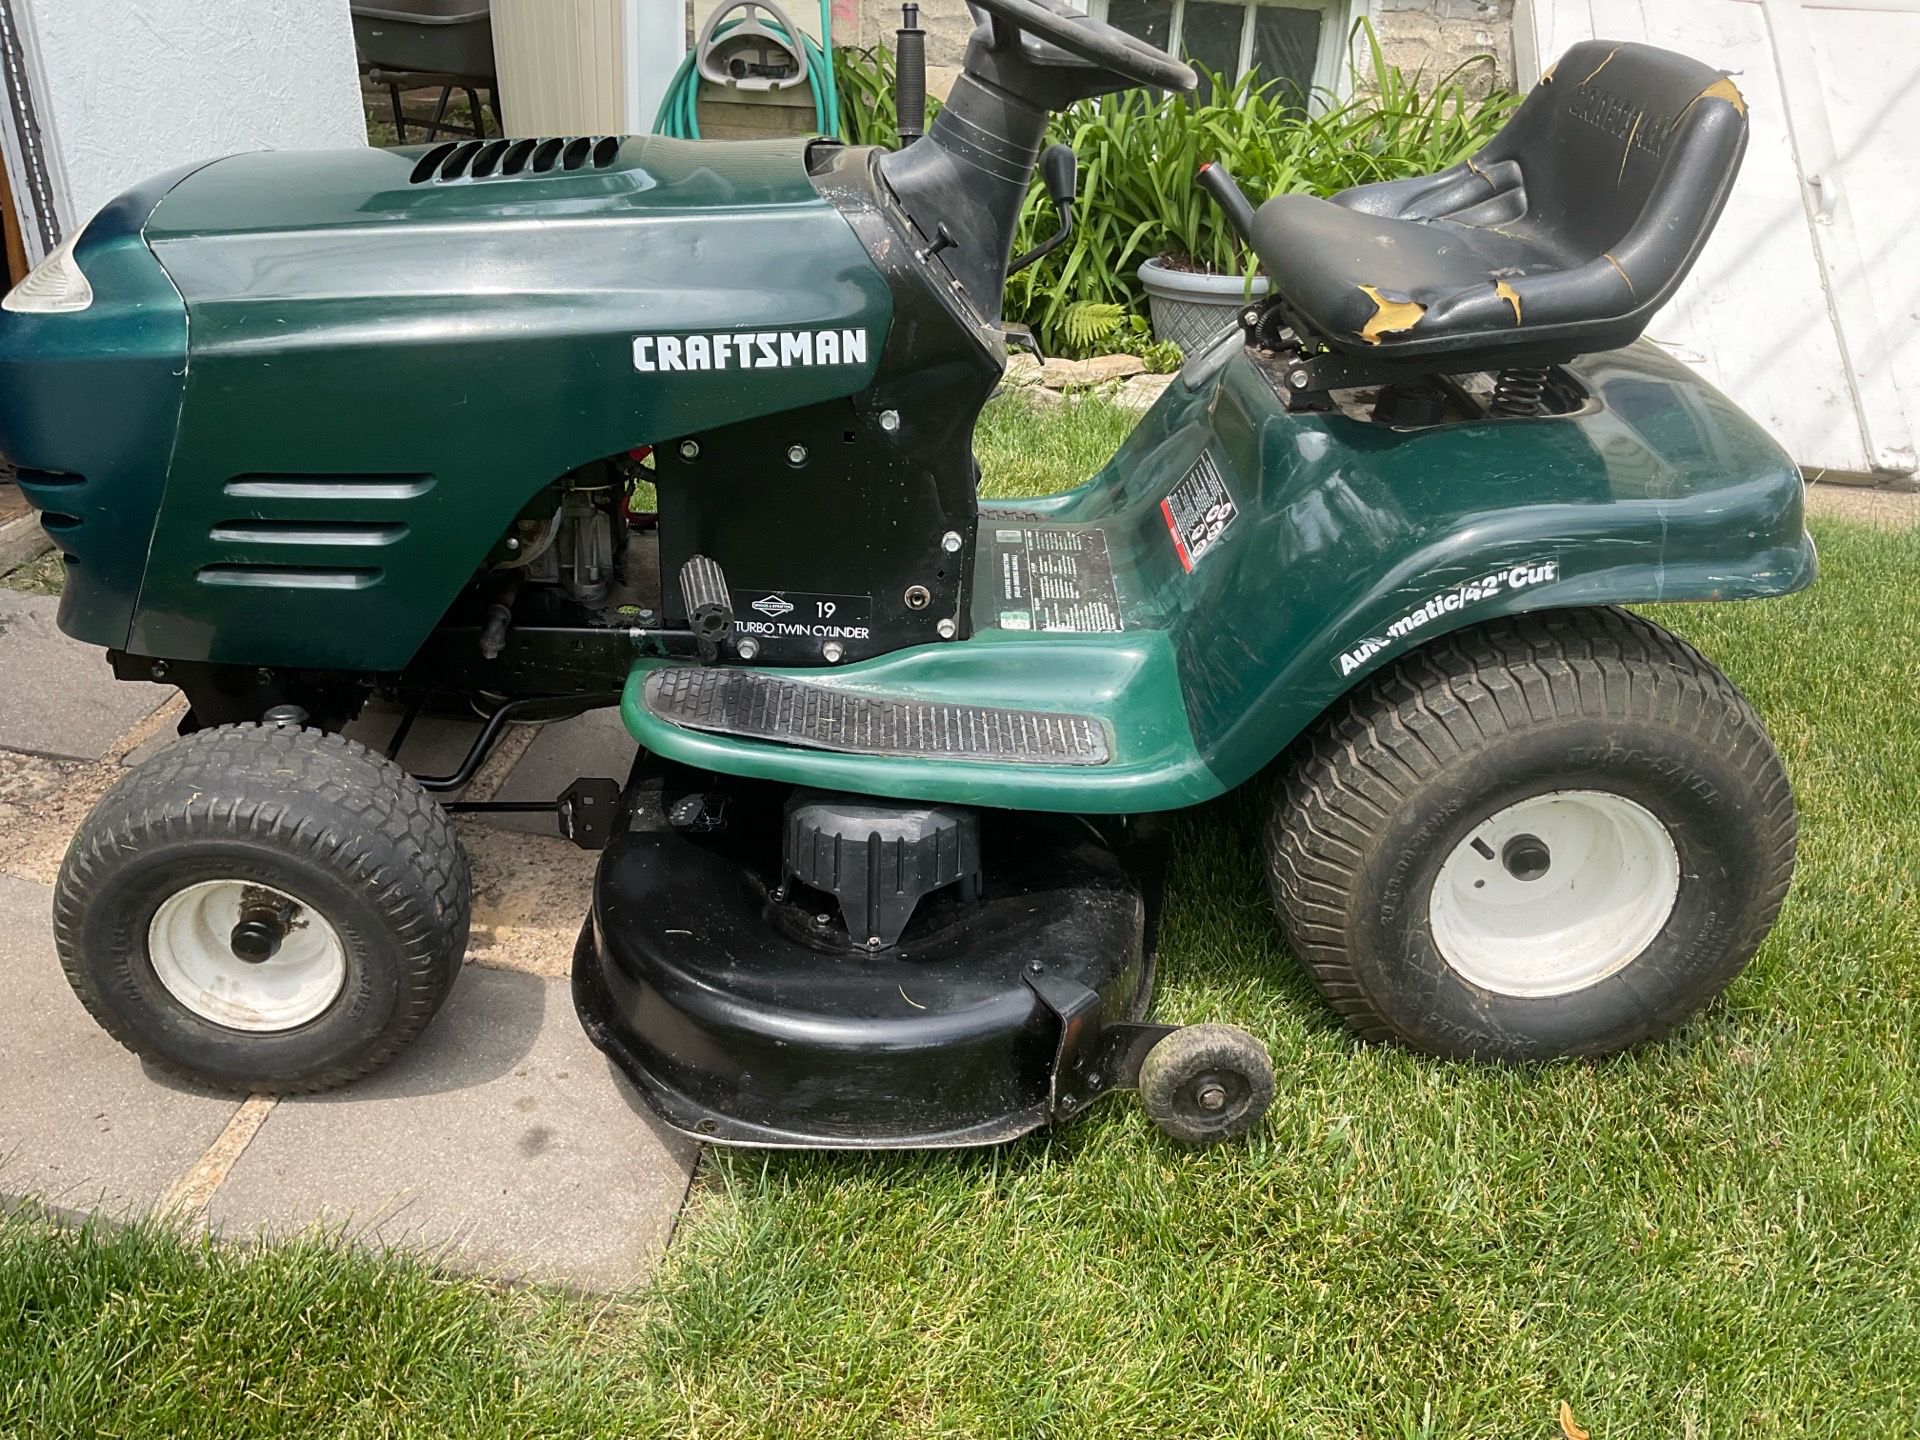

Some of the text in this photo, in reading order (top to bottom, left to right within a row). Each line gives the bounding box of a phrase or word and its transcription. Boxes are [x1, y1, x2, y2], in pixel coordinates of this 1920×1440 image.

[632, 329, 867, 372] CRAFTSMAN
[815, 601, 836, 618] 19
[734, 620, 870, 639] TURBO TWIN CYLINDER
